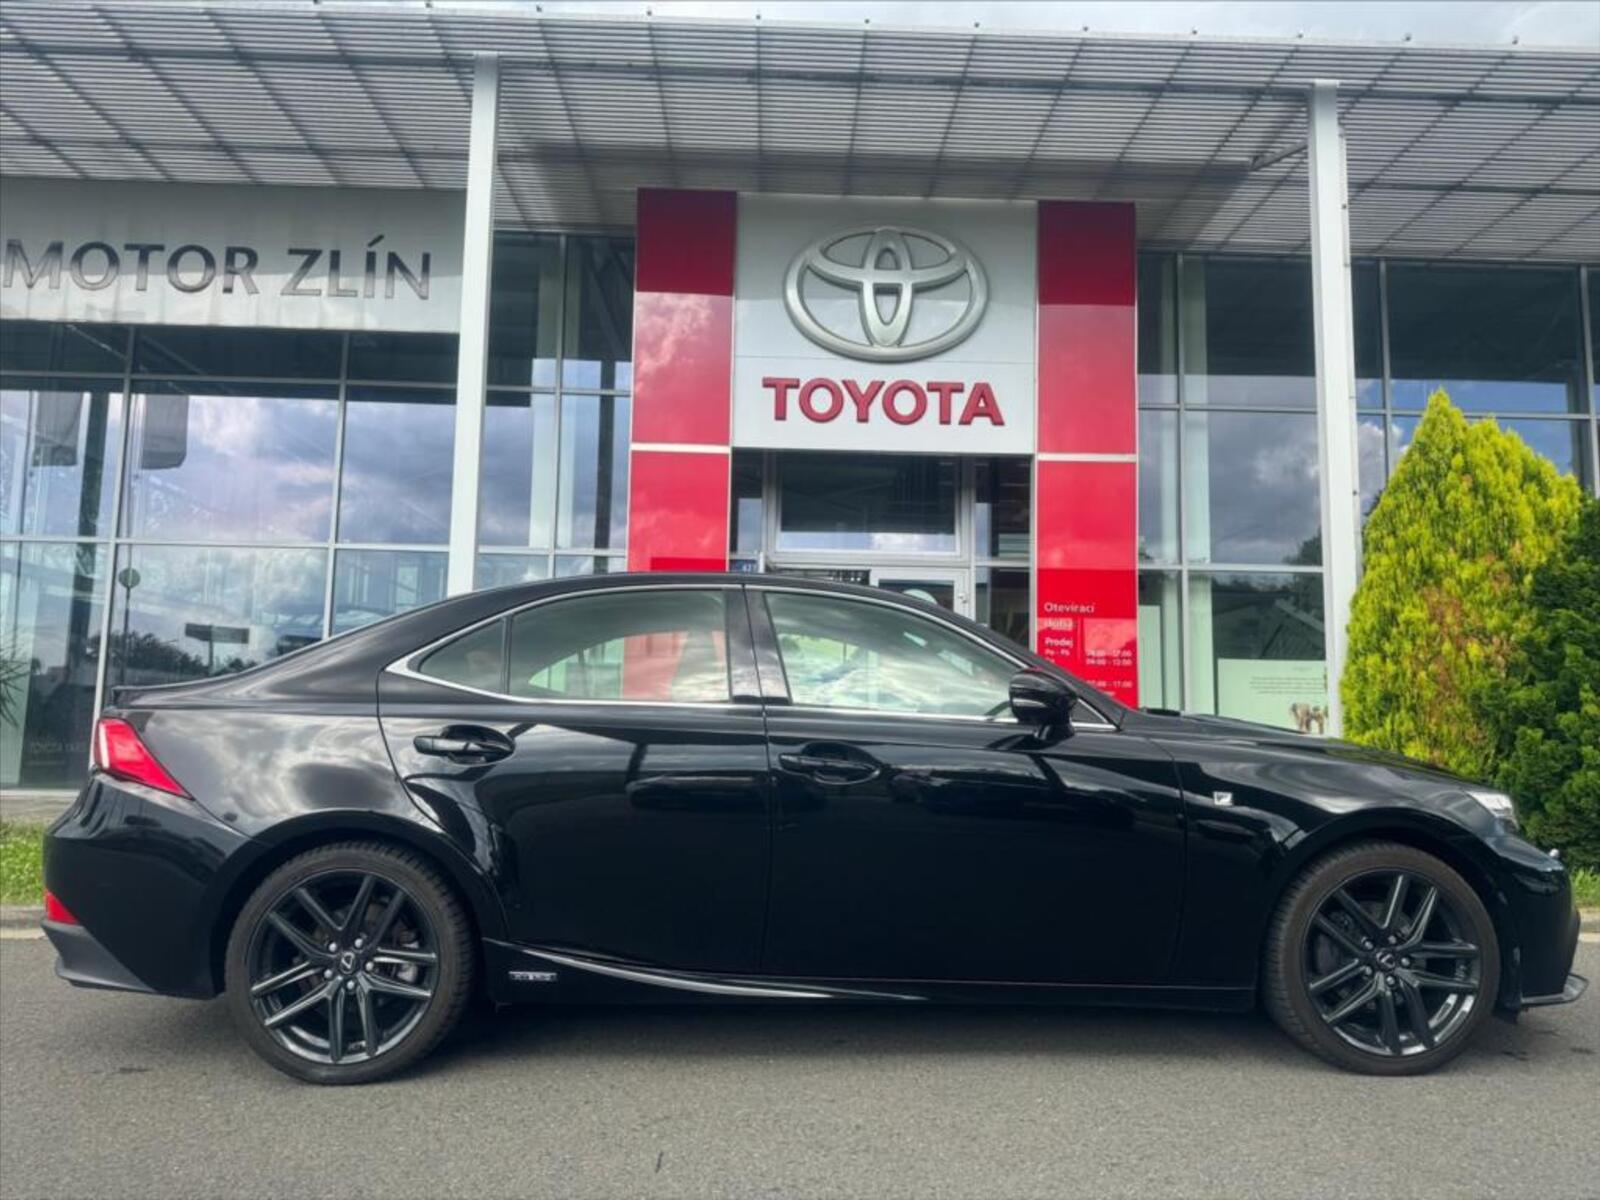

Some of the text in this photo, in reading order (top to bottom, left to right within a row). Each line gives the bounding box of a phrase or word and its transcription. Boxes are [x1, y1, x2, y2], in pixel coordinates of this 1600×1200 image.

[2, 234, 432, 301] MOTOR ZLÍN
[762, 376, 1005, 427] TOYOTA
